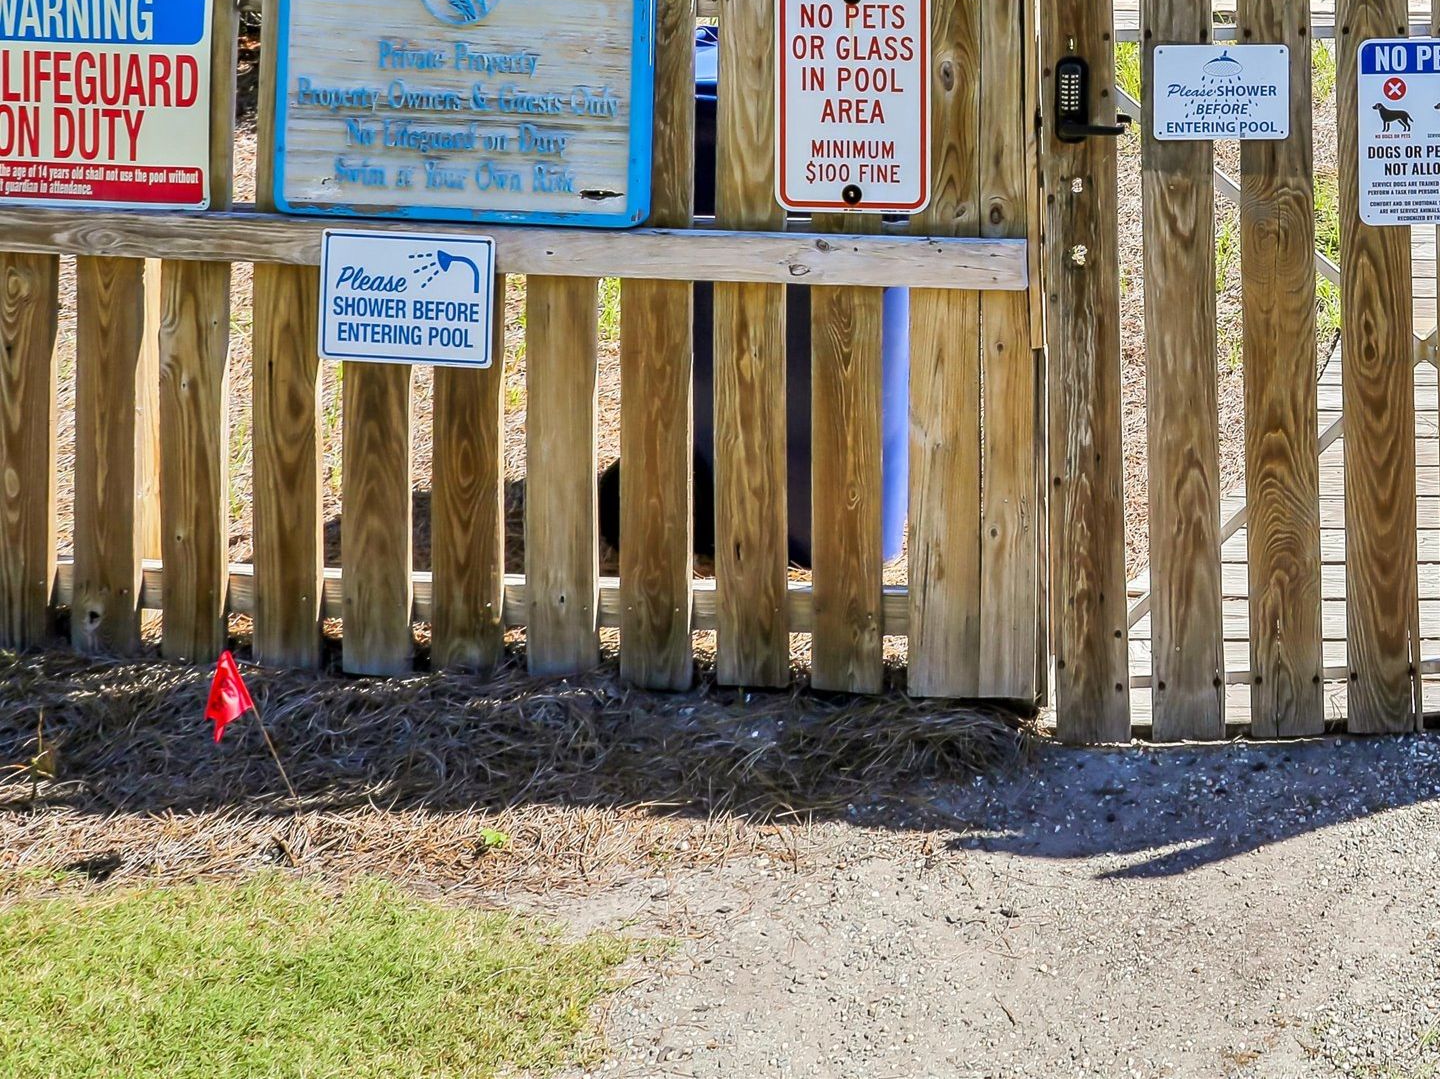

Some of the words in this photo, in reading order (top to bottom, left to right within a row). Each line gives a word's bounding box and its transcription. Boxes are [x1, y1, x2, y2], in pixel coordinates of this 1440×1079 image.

[800, 4, 832, 28] NO
[845, 5, 905, 29] PETS
[378, 39, 444, 69] Private
[455, 42, 539, 78] Property
[792, 35, 824, 60] OR
[836, 36, 914, 61] GLASS
[1375, 46, 1407, 71] NO
[2, 50, 199, 108] LIFEGUARD
[802, 67, 824, 91] IN
[837, 68, 903, 92] POOL
[1167, 84, 1215, 97] Please
[1217, 86, 1276, 97] SHOWER
[297, 76, 379, 113] Property
[388, 78, 461, 111] Owners
[470, 80, 491, 110] &
[498, 83, 561, 114] Guests
[571, 86, 620, 118] Only
[1196, 104, 1248, 115] BEFORE
[821, 99, 885, 123] AREA
[53, 107, 145, 161] DUTY
[345, 118, 376, 146] No
[383, 119, 477, 152] Lifeguard
[484, 133, 508, 151] on
[519, 123, 567, 158] Duty
[1167, 122, 1236, 133] ENTERING
[1240, 122, 1277, 133] POOL
[811, 140, 894, 159] MINIMUM
[1368, 145, 1400, 159] DOGS
[1405, 145, 1421, 158] OR
[13, 166, 25, 180] age
[28, 164, 35, 178] of
[38, 165, 46, 178] 14
[49, 168, 69, 182] years
[71, 166, 83, 180] old
[85, 166, 103, 180] shall
[105, 168, 117, 181] not
[120, 170, 132, 181] use
[135, 168, 146, 182] the
[148, 168, 166, 185] pool
[168, 169, 198, 184] without
[335, 156, 386, 186] Swim
[425, 160, 465, 189] Your
[475, 161, 521, 192] Own
[533, 163, 574, 192] Risk
[806, 161, 850, 184] $100
[859, 164, 900, 183] FINE
[1385, 162, 1407, 175] NOT
[5, 178, 37, 195] guardian
[40, 180, 47, 193] in
[49, 180, 92, 194] attendance.
[336, 266, 407, 292] Please
[333, 296, 406, 319] SHOWER
[413, 301, 479, 322] BEFORE
[337, 322, 421, 345] ENTERING
[428, 327, 473, 348] POOL
